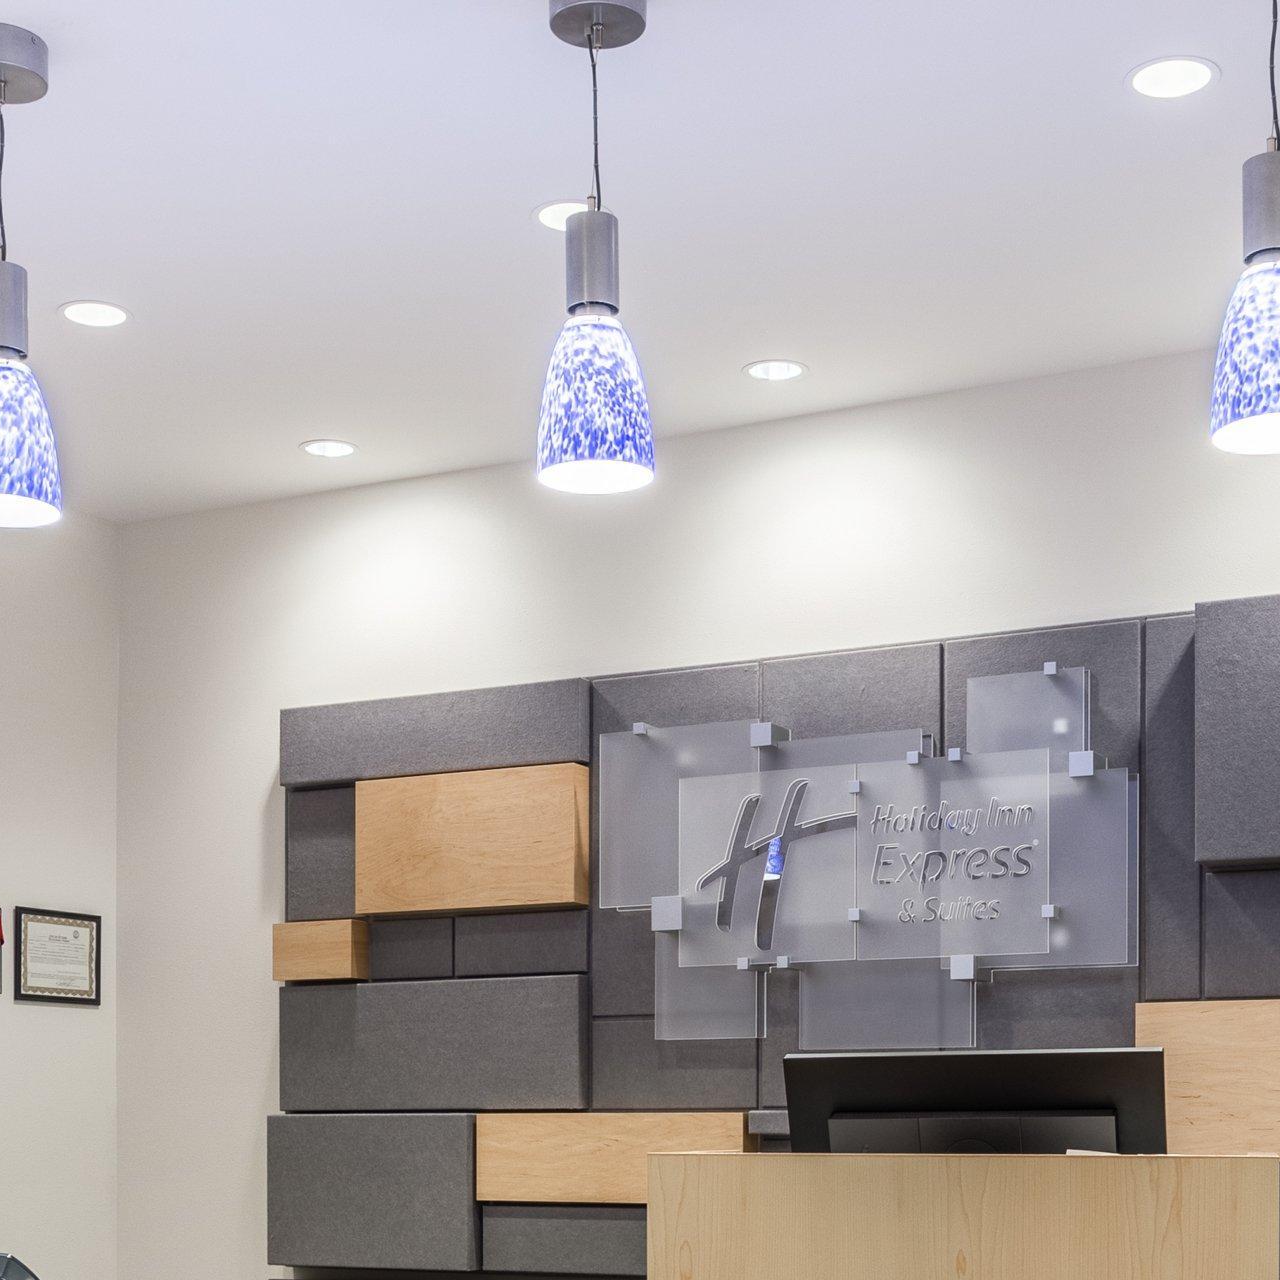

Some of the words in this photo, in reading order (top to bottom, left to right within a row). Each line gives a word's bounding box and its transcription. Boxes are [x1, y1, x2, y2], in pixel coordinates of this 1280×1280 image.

[870, 800, 981, 836] Holiday
[986, 796, 1033, 827] Inn
[871, 844, 1033, 893] Express
[898, 898, 916, 923] &
[922, 896, 1000, 922] Suites
